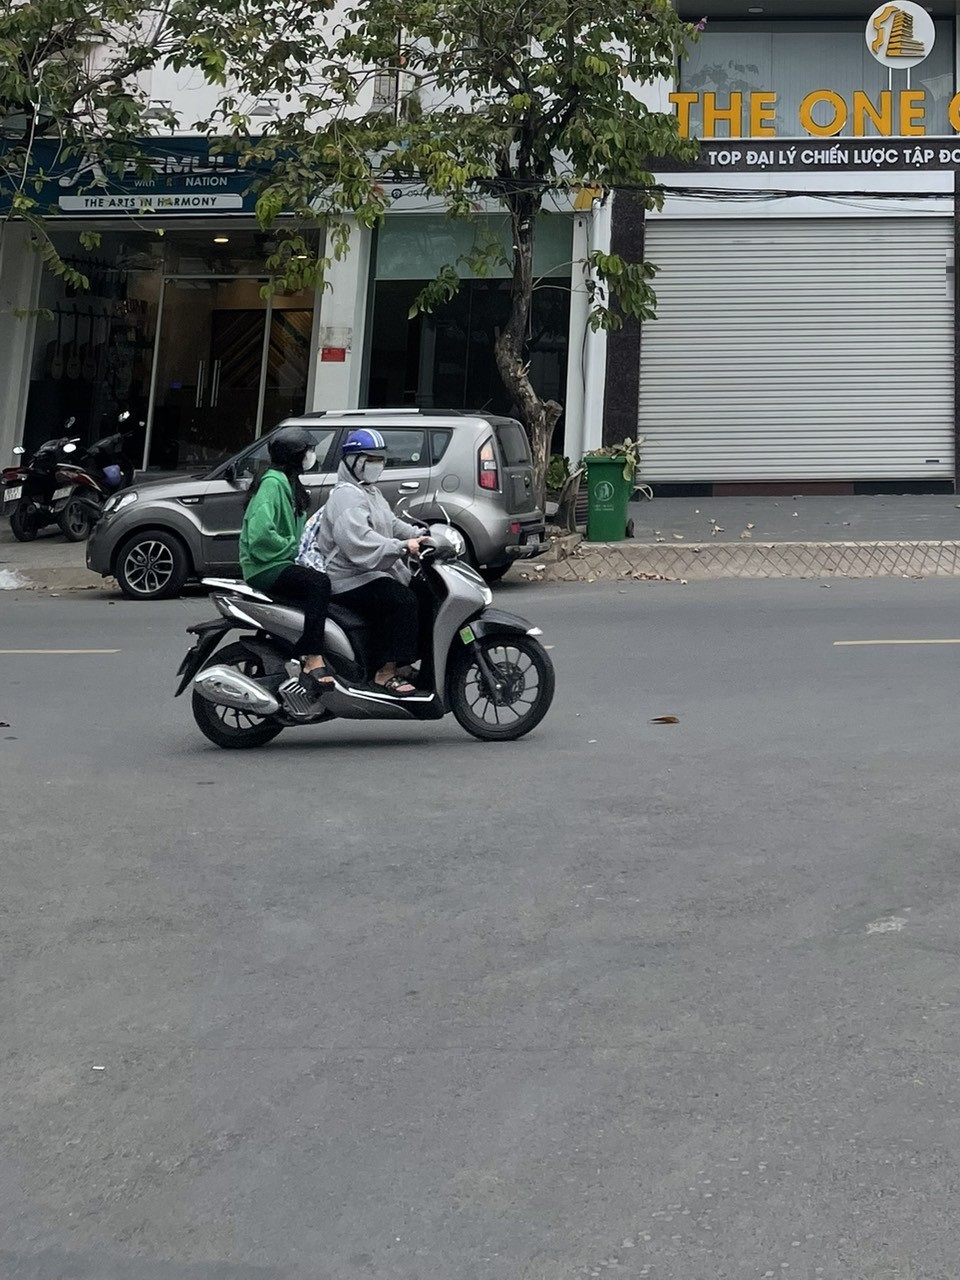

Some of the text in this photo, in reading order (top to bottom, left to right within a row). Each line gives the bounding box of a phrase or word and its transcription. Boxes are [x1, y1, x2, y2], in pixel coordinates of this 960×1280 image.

[669, 91, 777, 139] THE
[798, 89, 926, 138] ONE
[708, 150, 742, 166] TOP
[745, 150, 774, 169] ĐẠI
[778, 146, 797, 165] LÝ
[801, 143, 849, 165] CHIẾN
[854, 147, 899, 168] LƯỢC
[903, 146, 934, 168] TẬP
[185, 176, 228, 187] NATION
[84, 198, 104, 208] THE
[108, 198, 135, 207] ARTS
